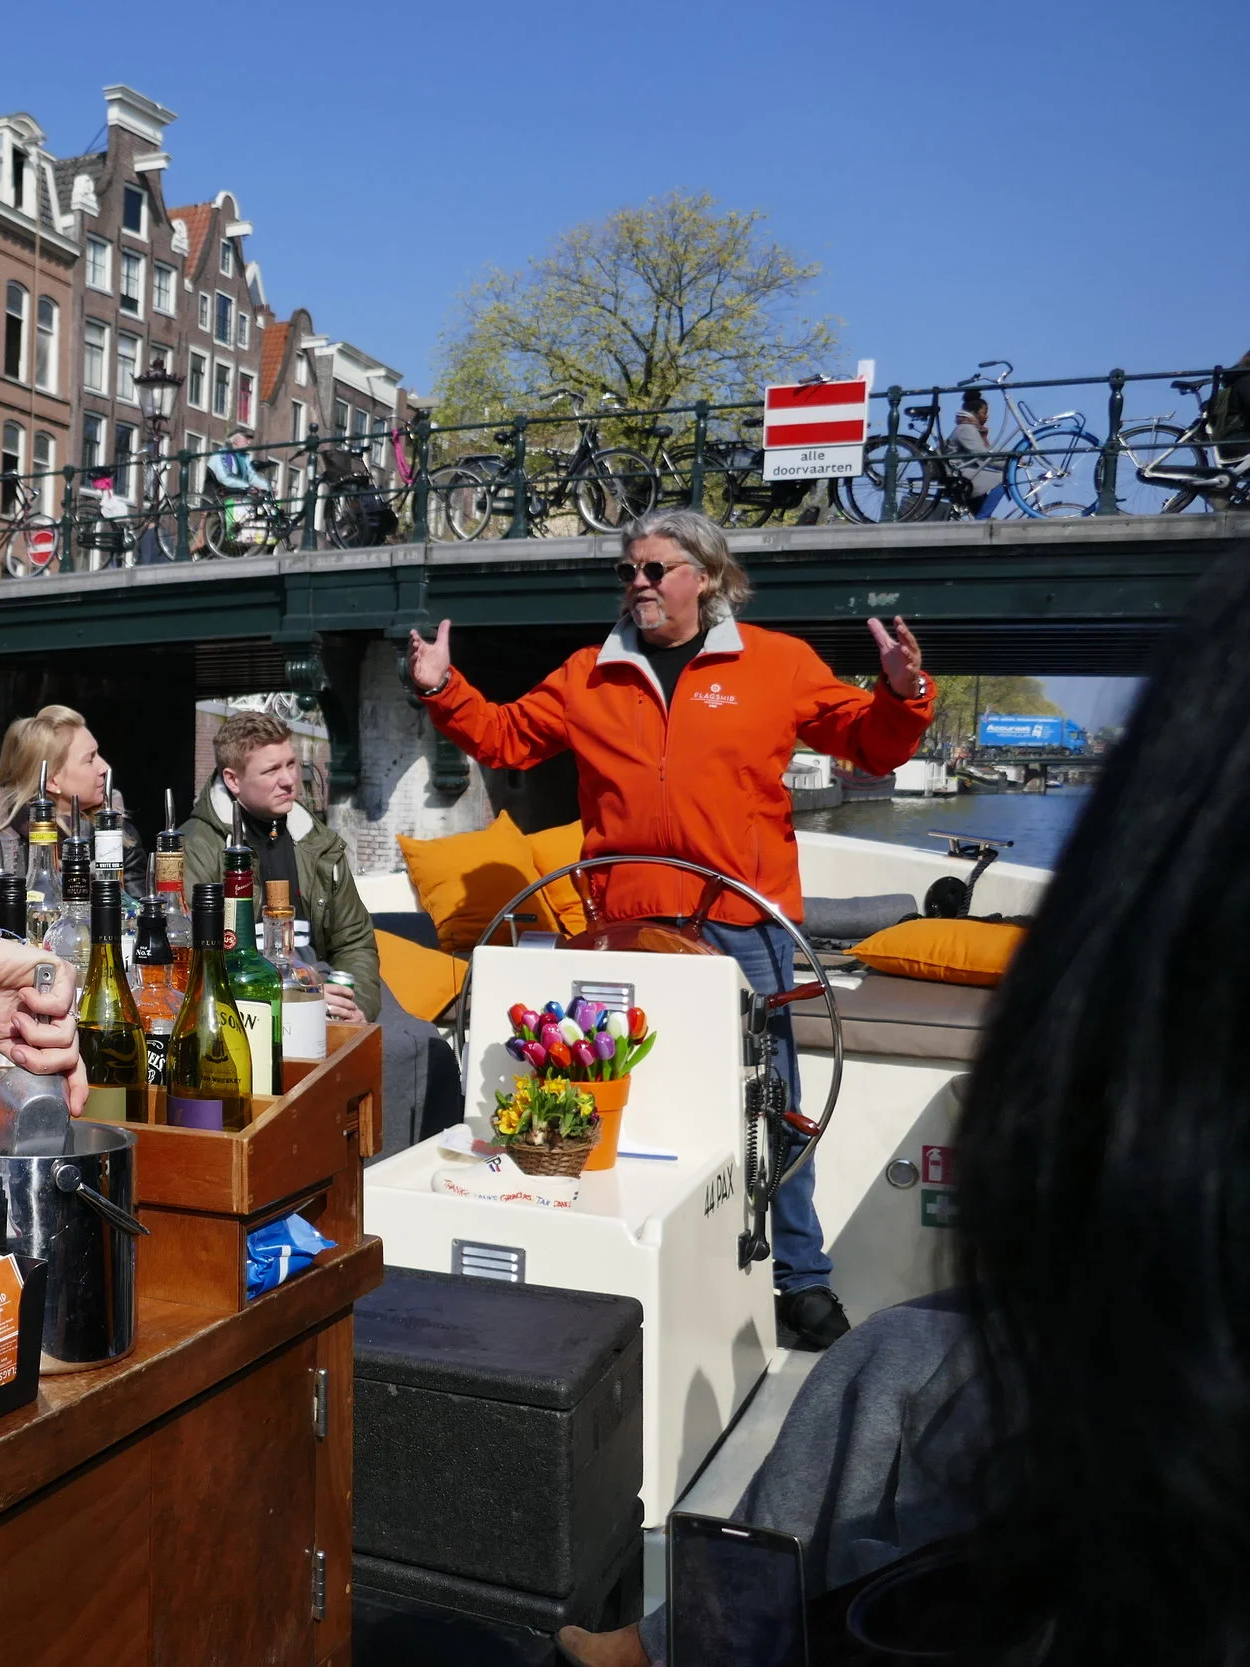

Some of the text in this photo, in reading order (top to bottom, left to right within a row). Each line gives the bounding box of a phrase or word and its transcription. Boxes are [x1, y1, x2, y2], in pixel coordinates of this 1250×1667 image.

[800, 450, 825, 461] alle
[772, 463, 852, 476] doorvaarten
[716, 1162, 735, 1209] PAX
